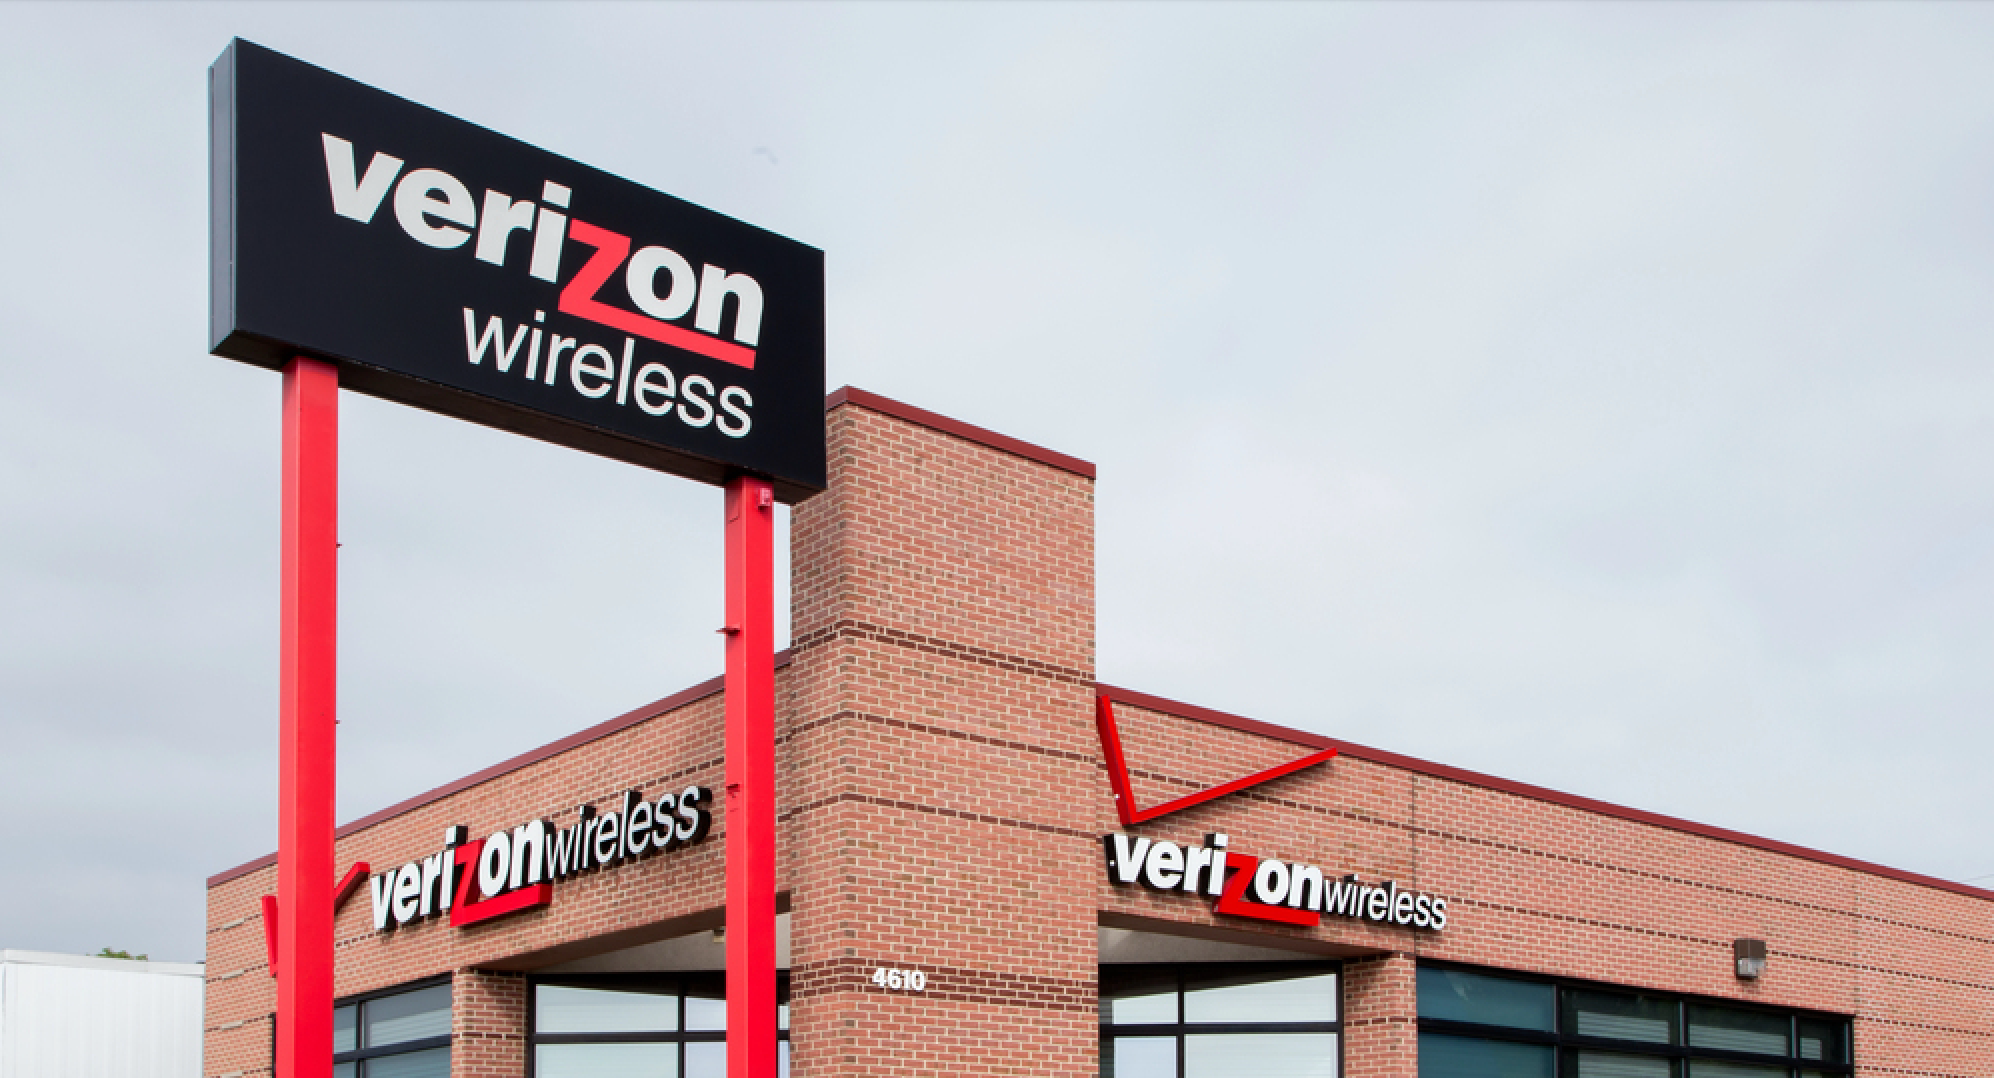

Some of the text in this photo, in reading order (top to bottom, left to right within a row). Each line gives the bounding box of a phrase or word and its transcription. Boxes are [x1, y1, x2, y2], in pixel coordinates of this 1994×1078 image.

[321, 132, 764, 370] verizon
[462, 306, 753, 438] wireless
[371, 785, 706, 929] verizon wireless
[1109, 832, 1447, 930] verizon wireless
[872, 967, 926, 990] 4610
